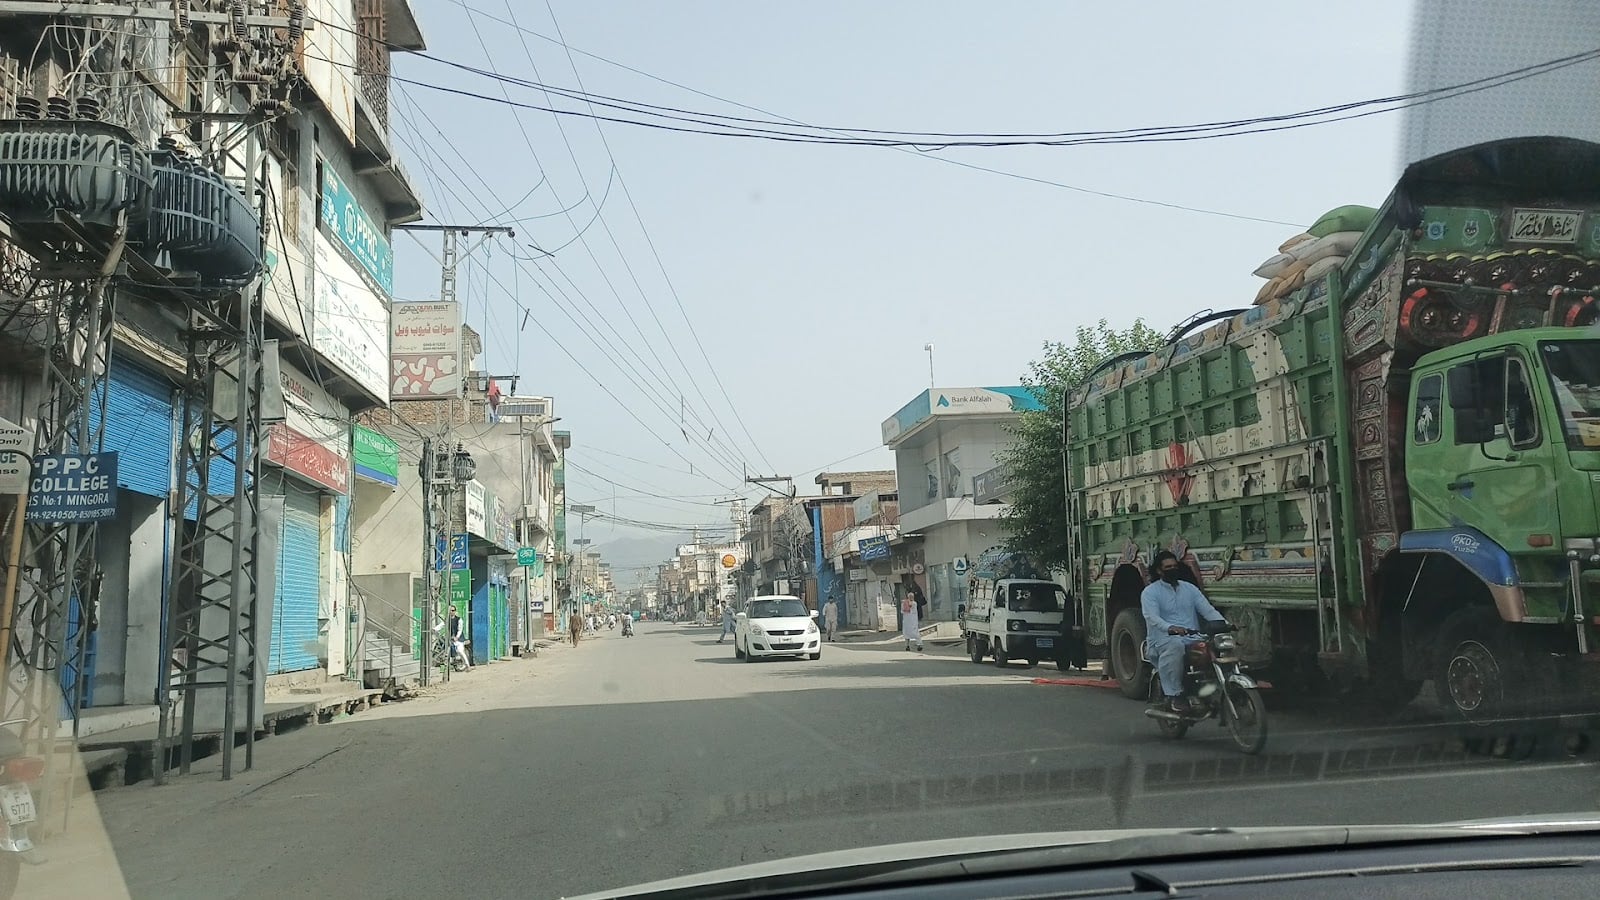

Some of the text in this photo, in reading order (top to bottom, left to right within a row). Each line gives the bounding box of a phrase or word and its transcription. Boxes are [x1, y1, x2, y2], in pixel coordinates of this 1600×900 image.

[356, 212, 378, 262] PPRC
[394, 323, 409, 337] ویل
[432, 322, 455, 336] سوات
[969, 395, 992, 403] Alfalah
[30, 475, 109, 493] COLLEGE
[66, 493, 109, 506] MINGORA
[11, 802, 30, 816] 6777
